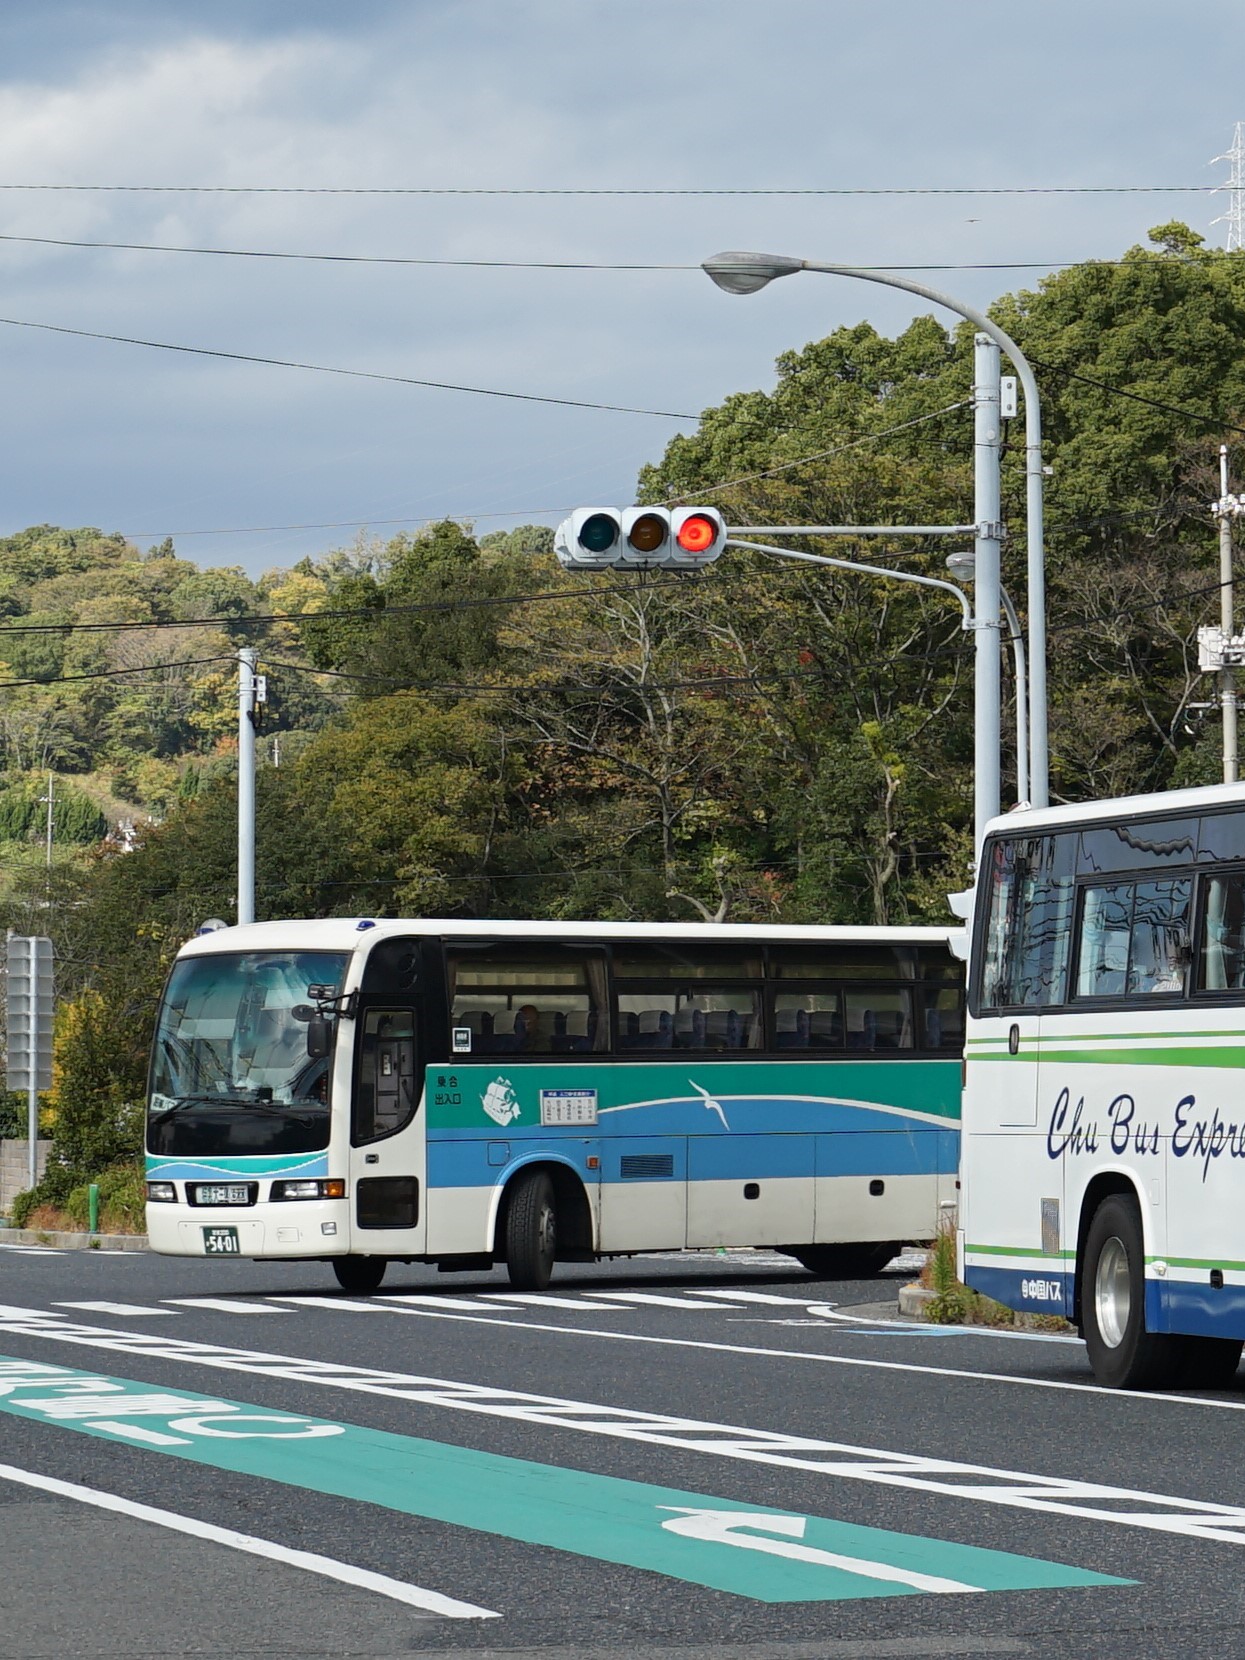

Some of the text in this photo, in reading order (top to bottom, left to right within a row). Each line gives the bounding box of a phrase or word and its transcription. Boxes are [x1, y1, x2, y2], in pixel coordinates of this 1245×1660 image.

[434, 1093, 461, 1105] 出入口
[1047, 1086, 1100, 1160] Chu
[1108, 1093, 1160, 1156] Bus
